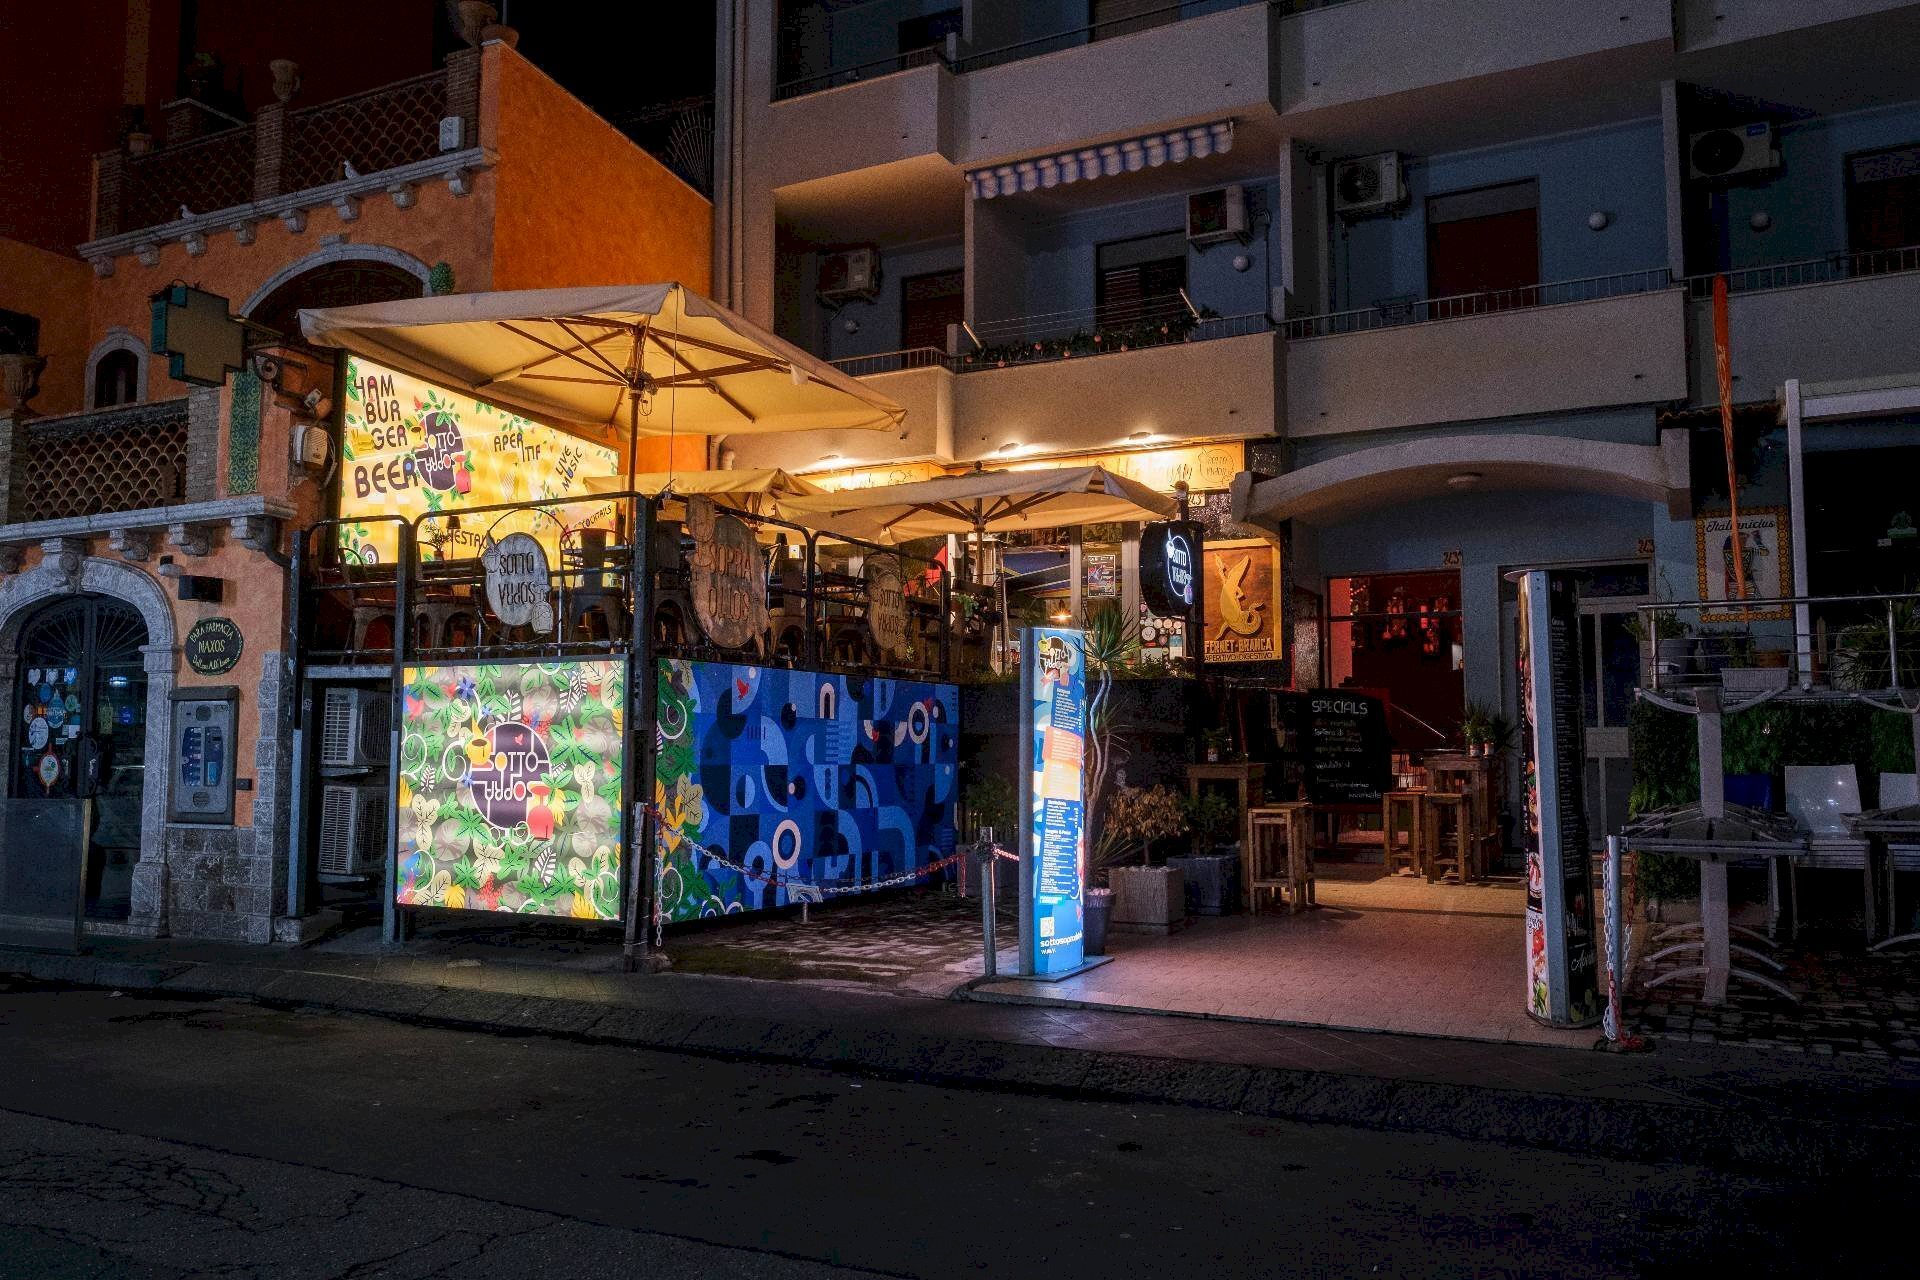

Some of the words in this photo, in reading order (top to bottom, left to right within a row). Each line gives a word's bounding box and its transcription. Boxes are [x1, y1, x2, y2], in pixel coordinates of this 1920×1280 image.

[366, 399, 401, 424] BUR
[371, 425, 408, 450] GER
[494, 432, 523, 452] APER
[556, 445, 572, 476] LIVE
[562, 447, 583, 491] MUSIC
[354, 457, 419, 498] BEER
[582, 505, 612, 529] COCKTAILS
[500, 552, 535, 576] SOTTO
[710, 543, 752, 581] SOPRA
[498, 581, 536, 607] SOPRA
[198, 639, 226, 653] NAXOS
[1311, 700, 1369, 715] SPECIALS
